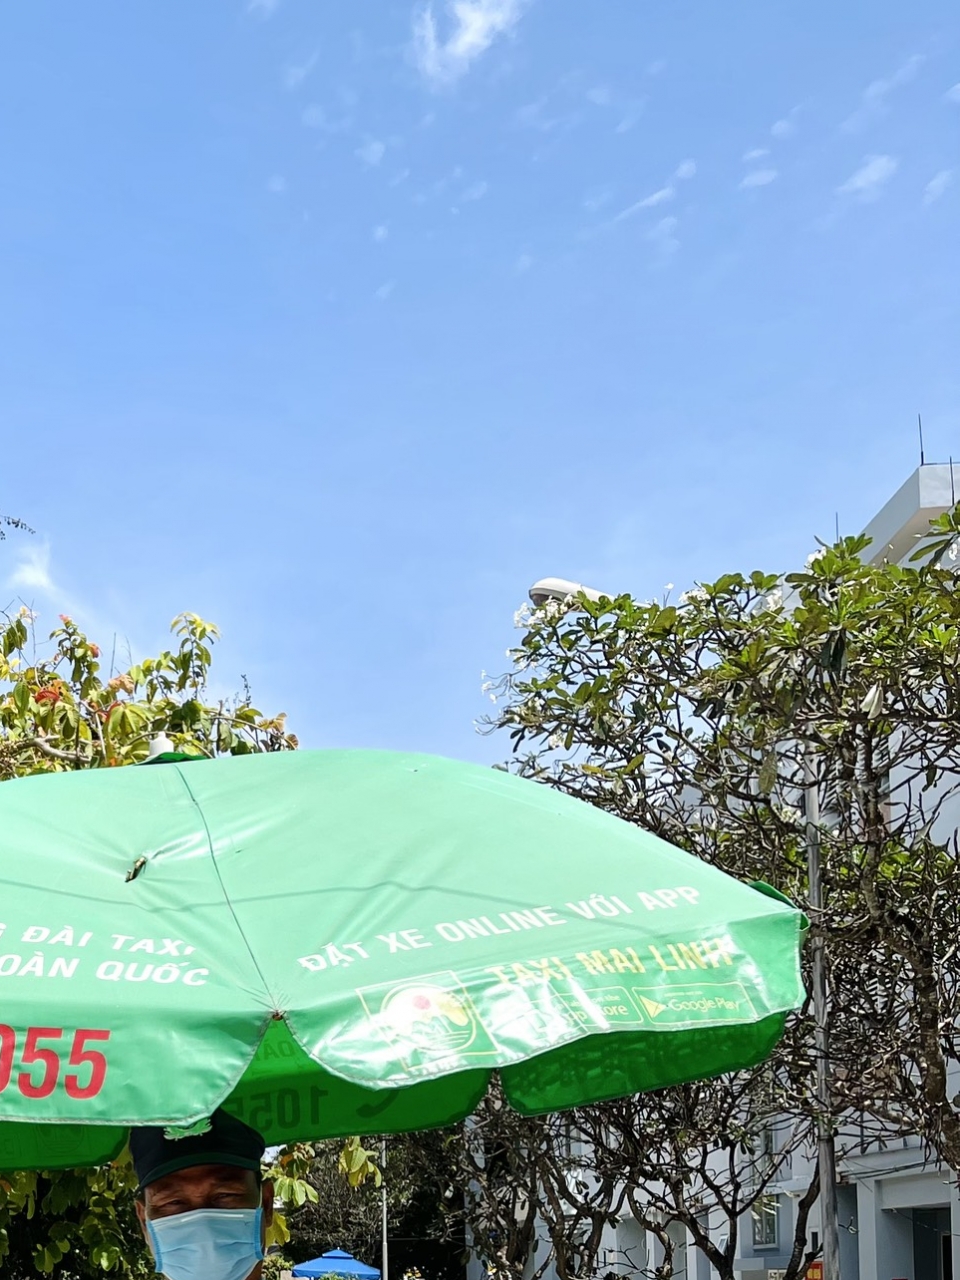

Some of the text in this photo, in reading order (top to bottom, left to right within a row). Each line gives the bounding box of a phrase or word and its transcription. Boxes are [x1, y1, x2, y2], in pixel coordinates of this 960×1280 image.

[21, 925, 93, 947] ĐÀI
[296, 886, 701, 972] ĐẶT XE ONLINE VỚI APP
[95, 960, 210, 986] QUỐC
[484, 938, 734, 985] TAXI MAI LINH
[668, 997, 739, 1013] Google Play
